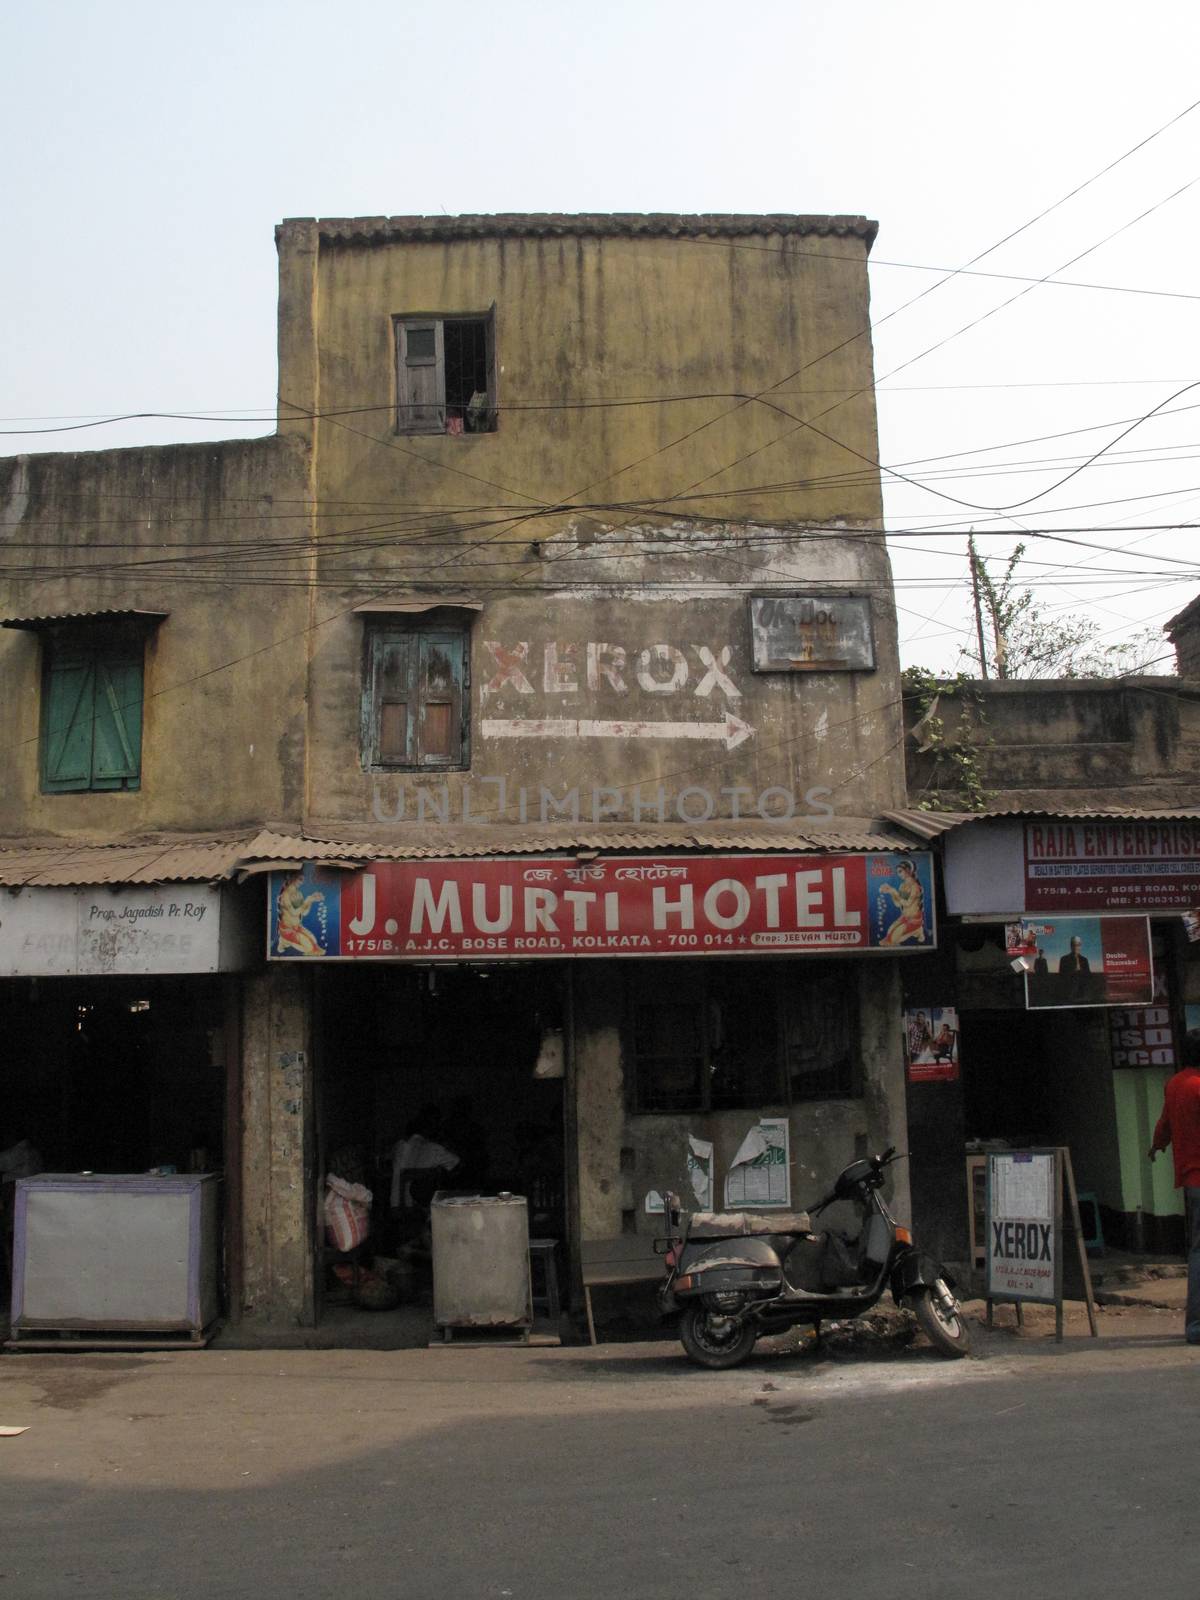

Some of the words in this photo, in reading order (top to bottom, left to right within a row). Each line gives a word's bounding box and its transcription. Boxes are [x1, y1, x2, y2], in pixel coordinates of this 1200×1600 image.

[482, 641, 743, 697] XEROX
[1033, 825, 1077, 857] RAJA
[615, 863, 688, 881] হোটেল
[1112, 885, 1142, 893] BOSE
[652, 867, 861, 931] HOTEL
[118, 904, 164, 923] Jagadish
[184, 902, 207, 921] Roy
[405, 938, 455, 950] A.J.C.
[462, 937, 508, 950] BOSE
[514, 936, 566, 951] ROAD,
[572, 935, 651, 947] KOLKATA
[668, 934, 698, 946] 700
[704, 934, 734, 945] 014
[784, 932, 821, 943] JEEVAN
[1110, 1008, 1169, 1027] STD
[1112, 1028, 1172, 1047] ISD
[1113, 1048, 1174, 1066] PCO
[992, 1221, 1052, 1262] XEROX
